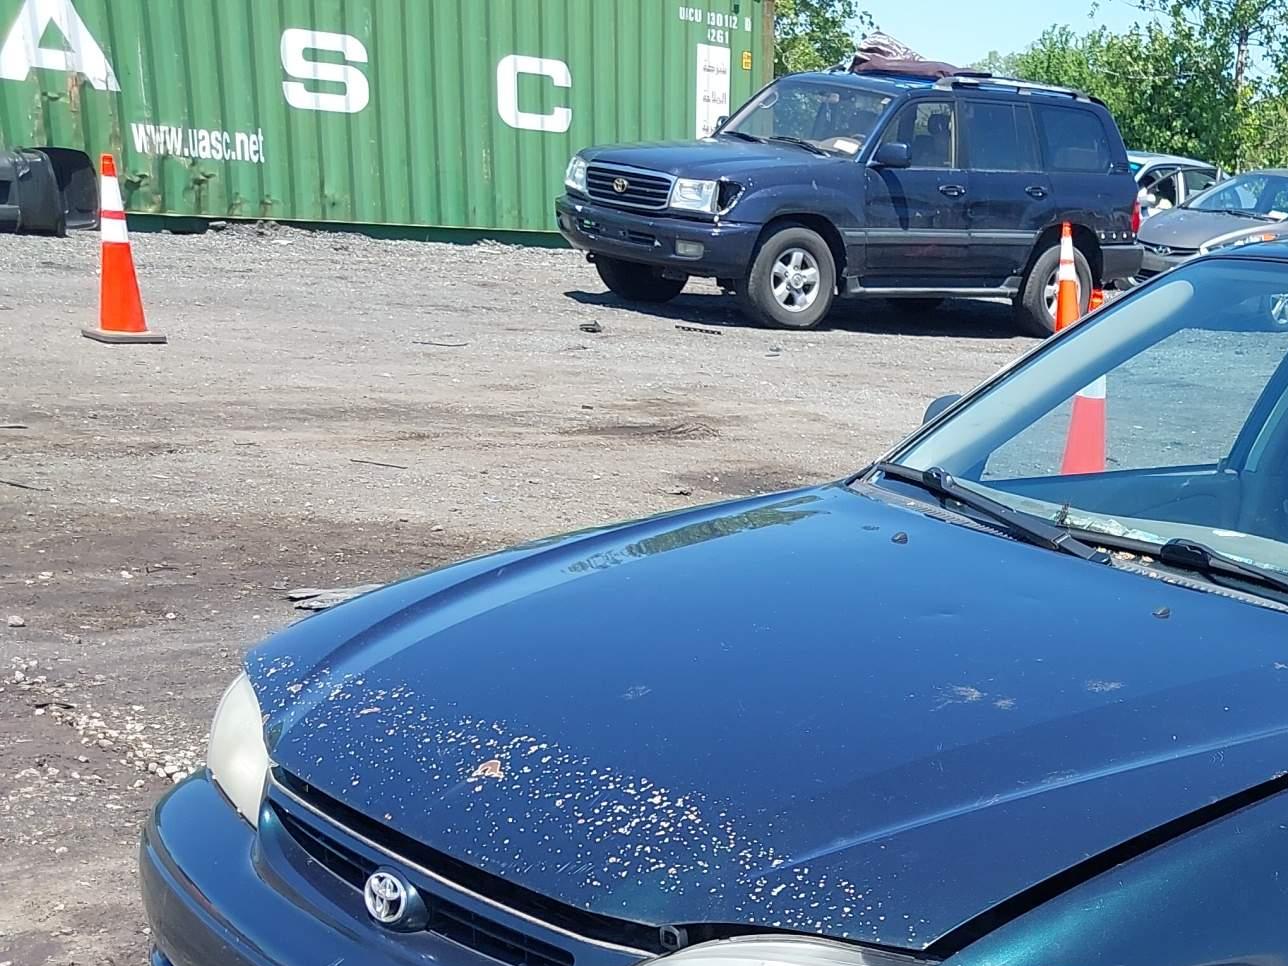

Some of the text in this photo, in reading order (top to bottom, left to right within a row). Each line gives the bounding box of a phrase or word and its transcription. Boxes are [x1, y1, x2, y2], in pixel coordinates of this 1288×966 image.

[0, 0, 572, 133] A S C
[131, 123, 265, 163] www.uasc.net
